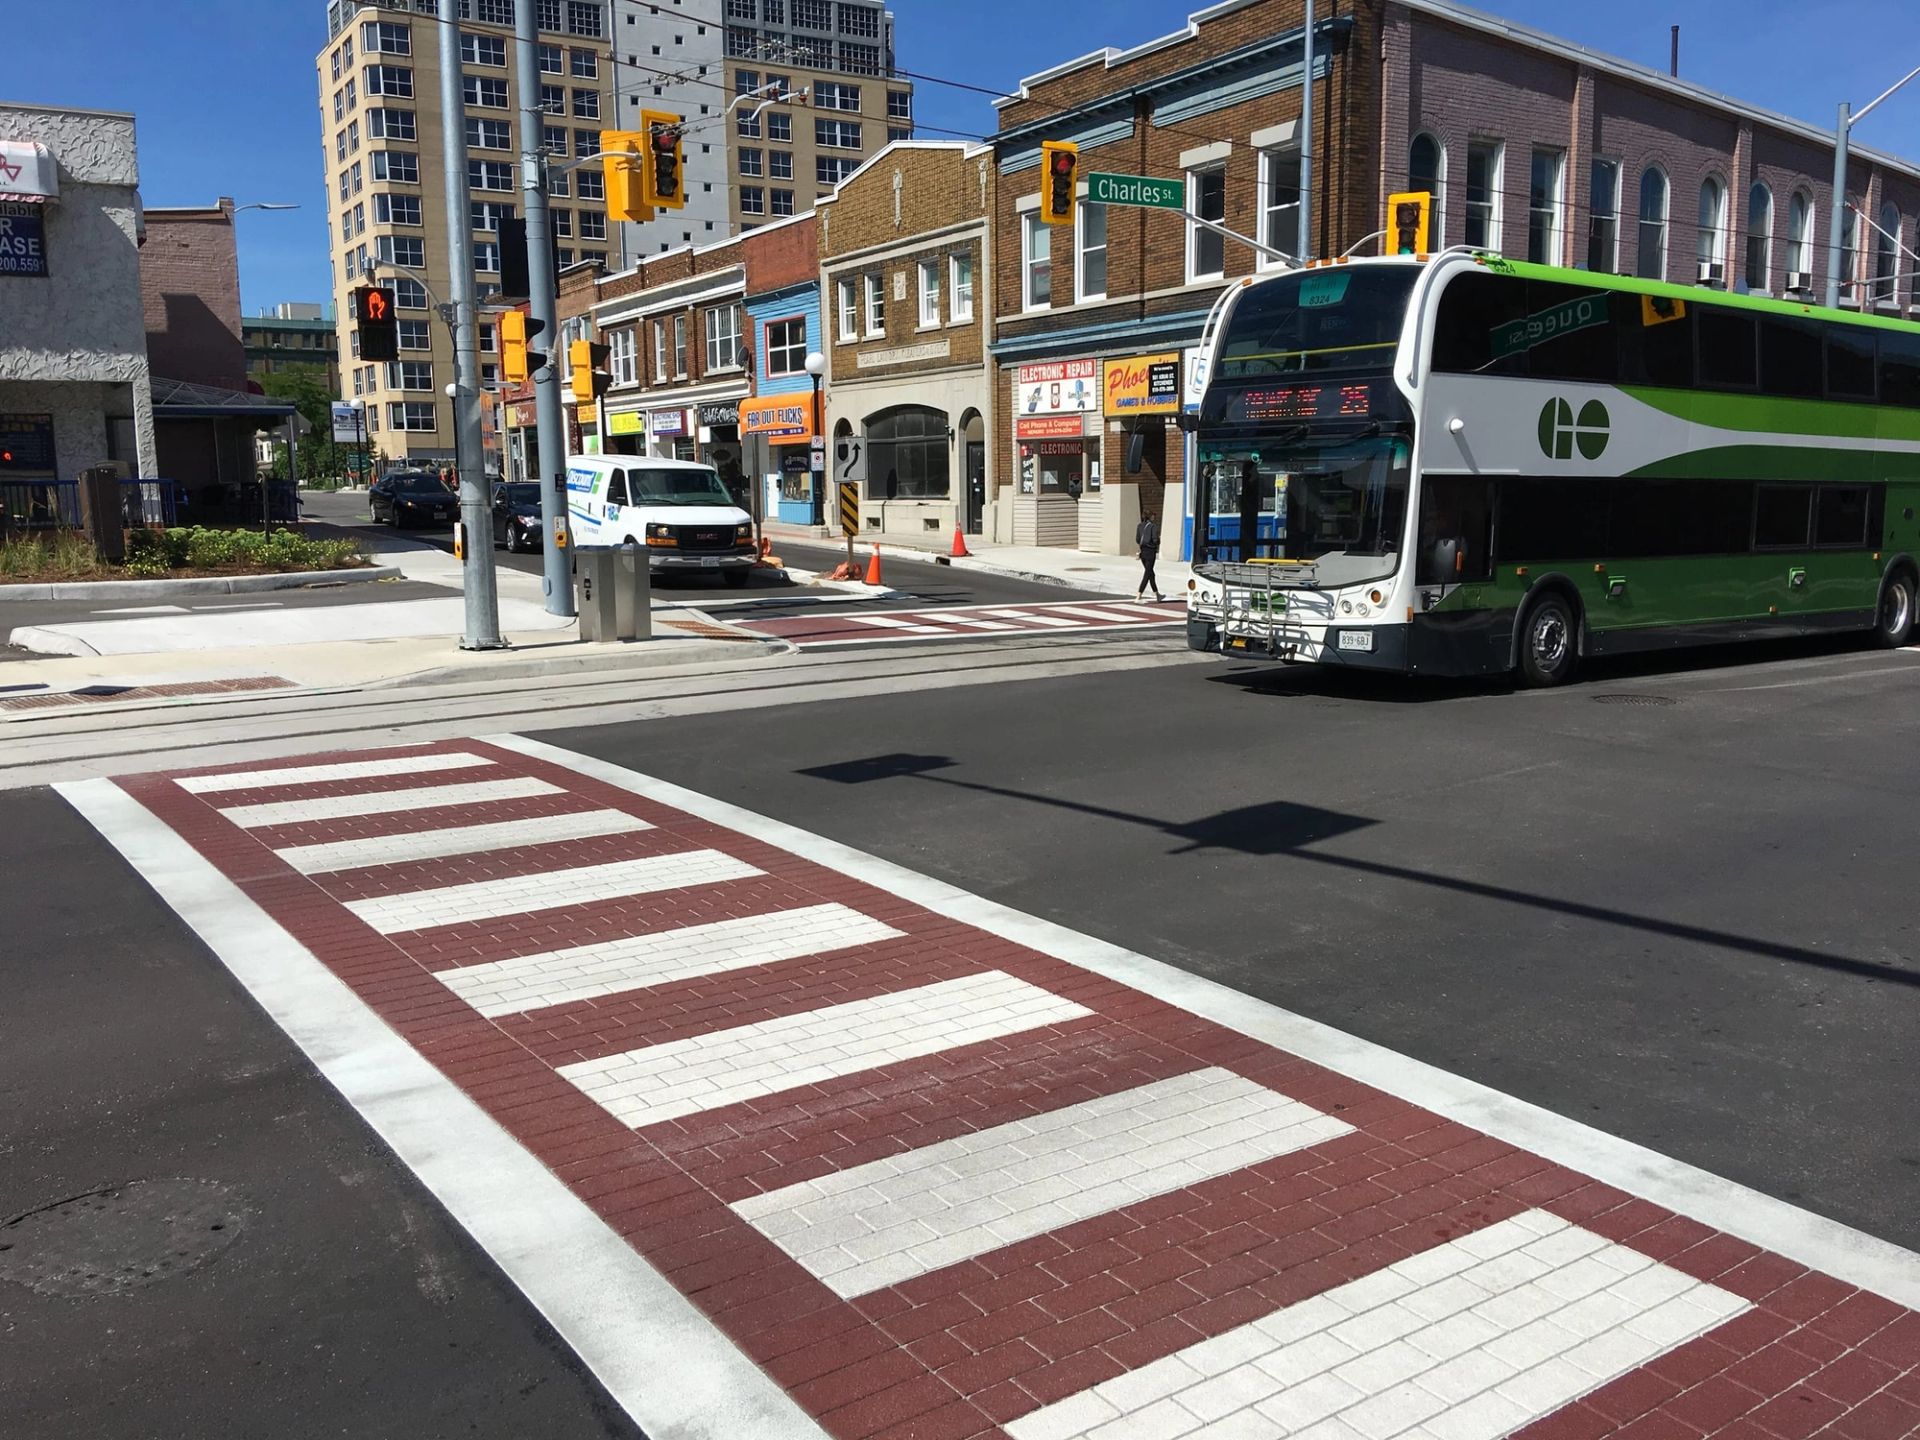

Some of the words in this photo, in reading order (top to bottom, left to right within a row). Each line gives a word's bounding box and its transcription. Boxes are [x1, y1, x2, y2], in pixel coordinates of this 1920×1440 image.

[1098, 179, 1160, 203] Charles
[1162, 188, 1174, 200] St.
[1021, 364, 1064, 382] ELECTRONIC
[1066, 361, 1093, 379] REPAIR
[1116, 397, 1139, 407] GAMES
[1141, 396, 1146, 406] &
[1147, 394, 1177, 406] HOBBIES
[762, 409, 775, 425] OUT
[777, 407, 803, 425] FLICKS
[1041, 443, 1082, 455] ELECTRONIC
